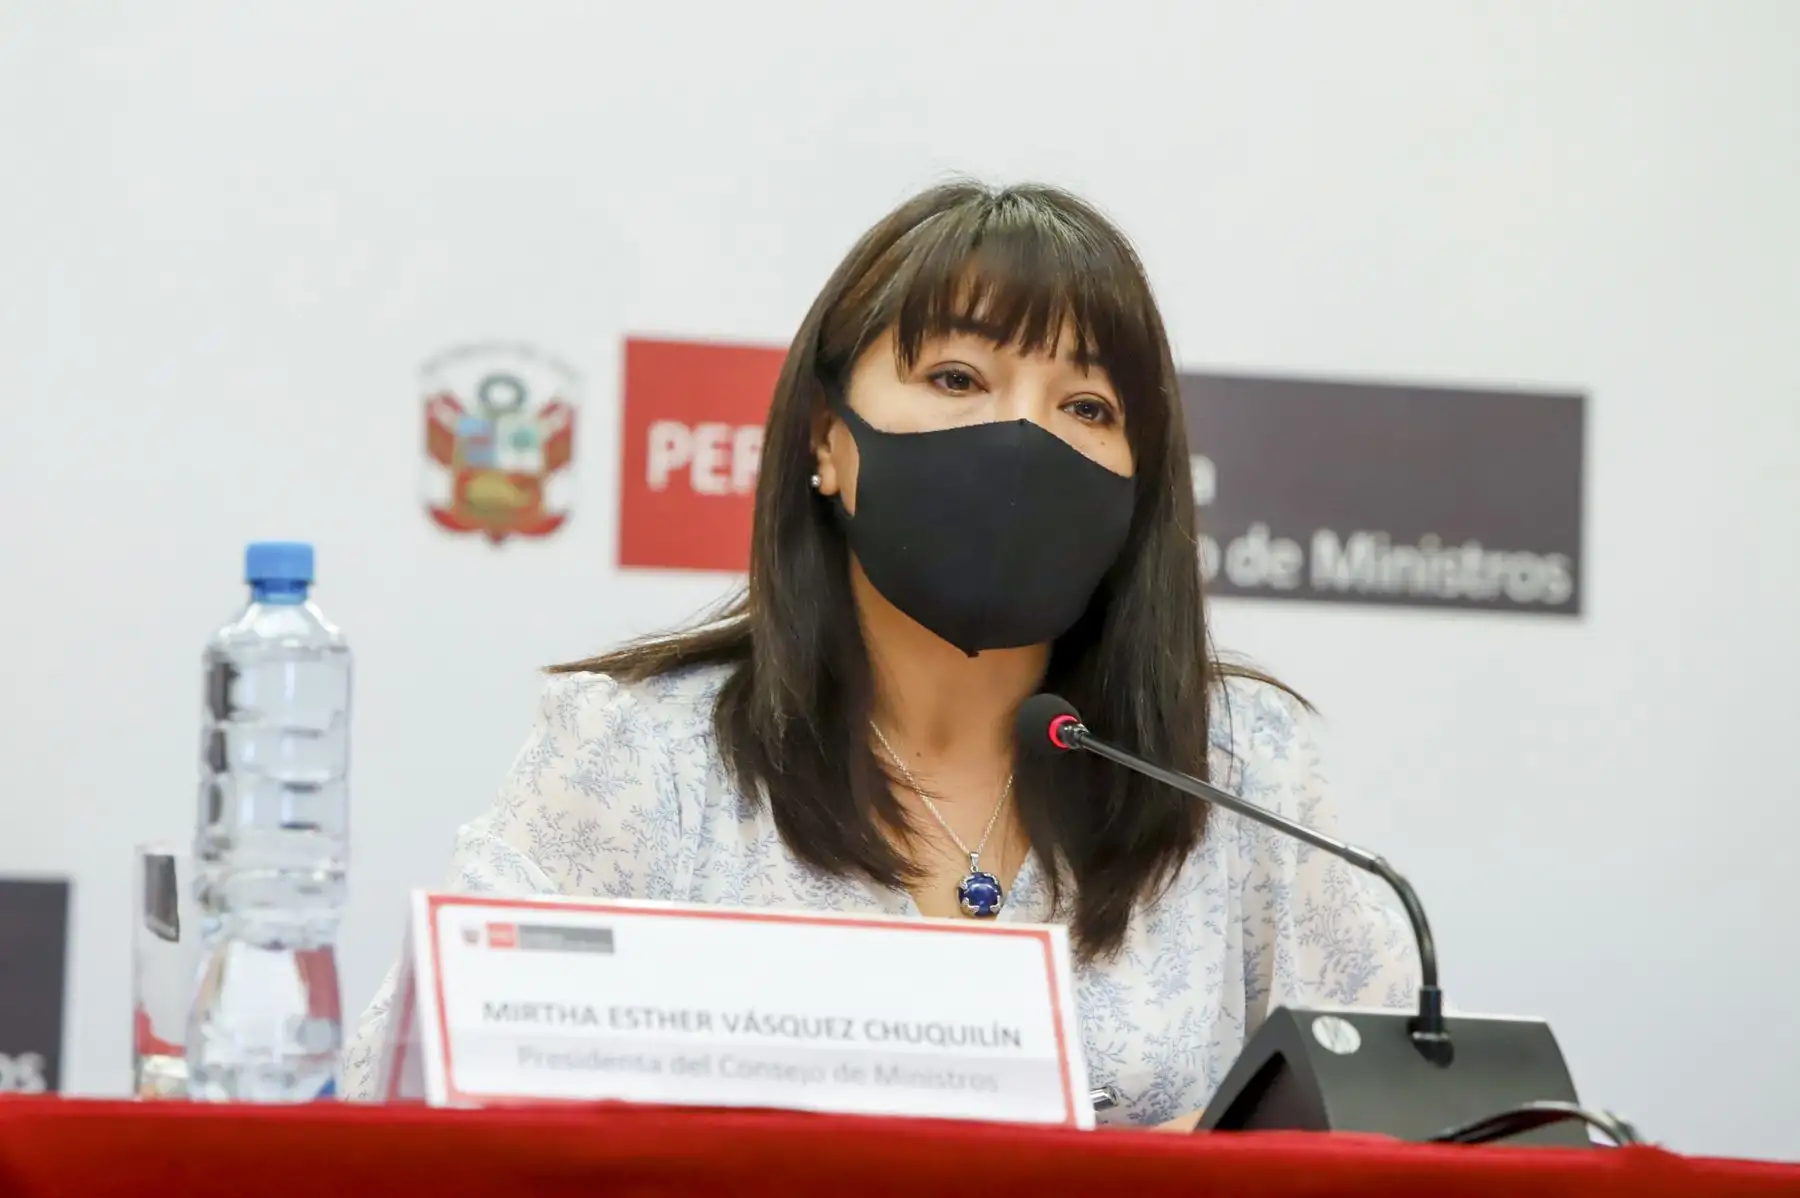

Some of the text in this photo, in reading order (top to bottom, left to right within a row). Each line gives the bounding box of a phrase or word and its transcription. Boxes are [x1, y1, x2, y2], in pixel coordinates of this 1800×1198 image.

[646, 419, 765, 496] PER
[1225, 519, 1303, 590] de
[1310, 527, 1573, 605] Ministros
[482, 1000, 1023, 1050] MIRTHA ESTHER VÁSQUEZ CHUQUILÍN
[517, 1045, 999, 1094] Presidenta del Consejo de Ministros
